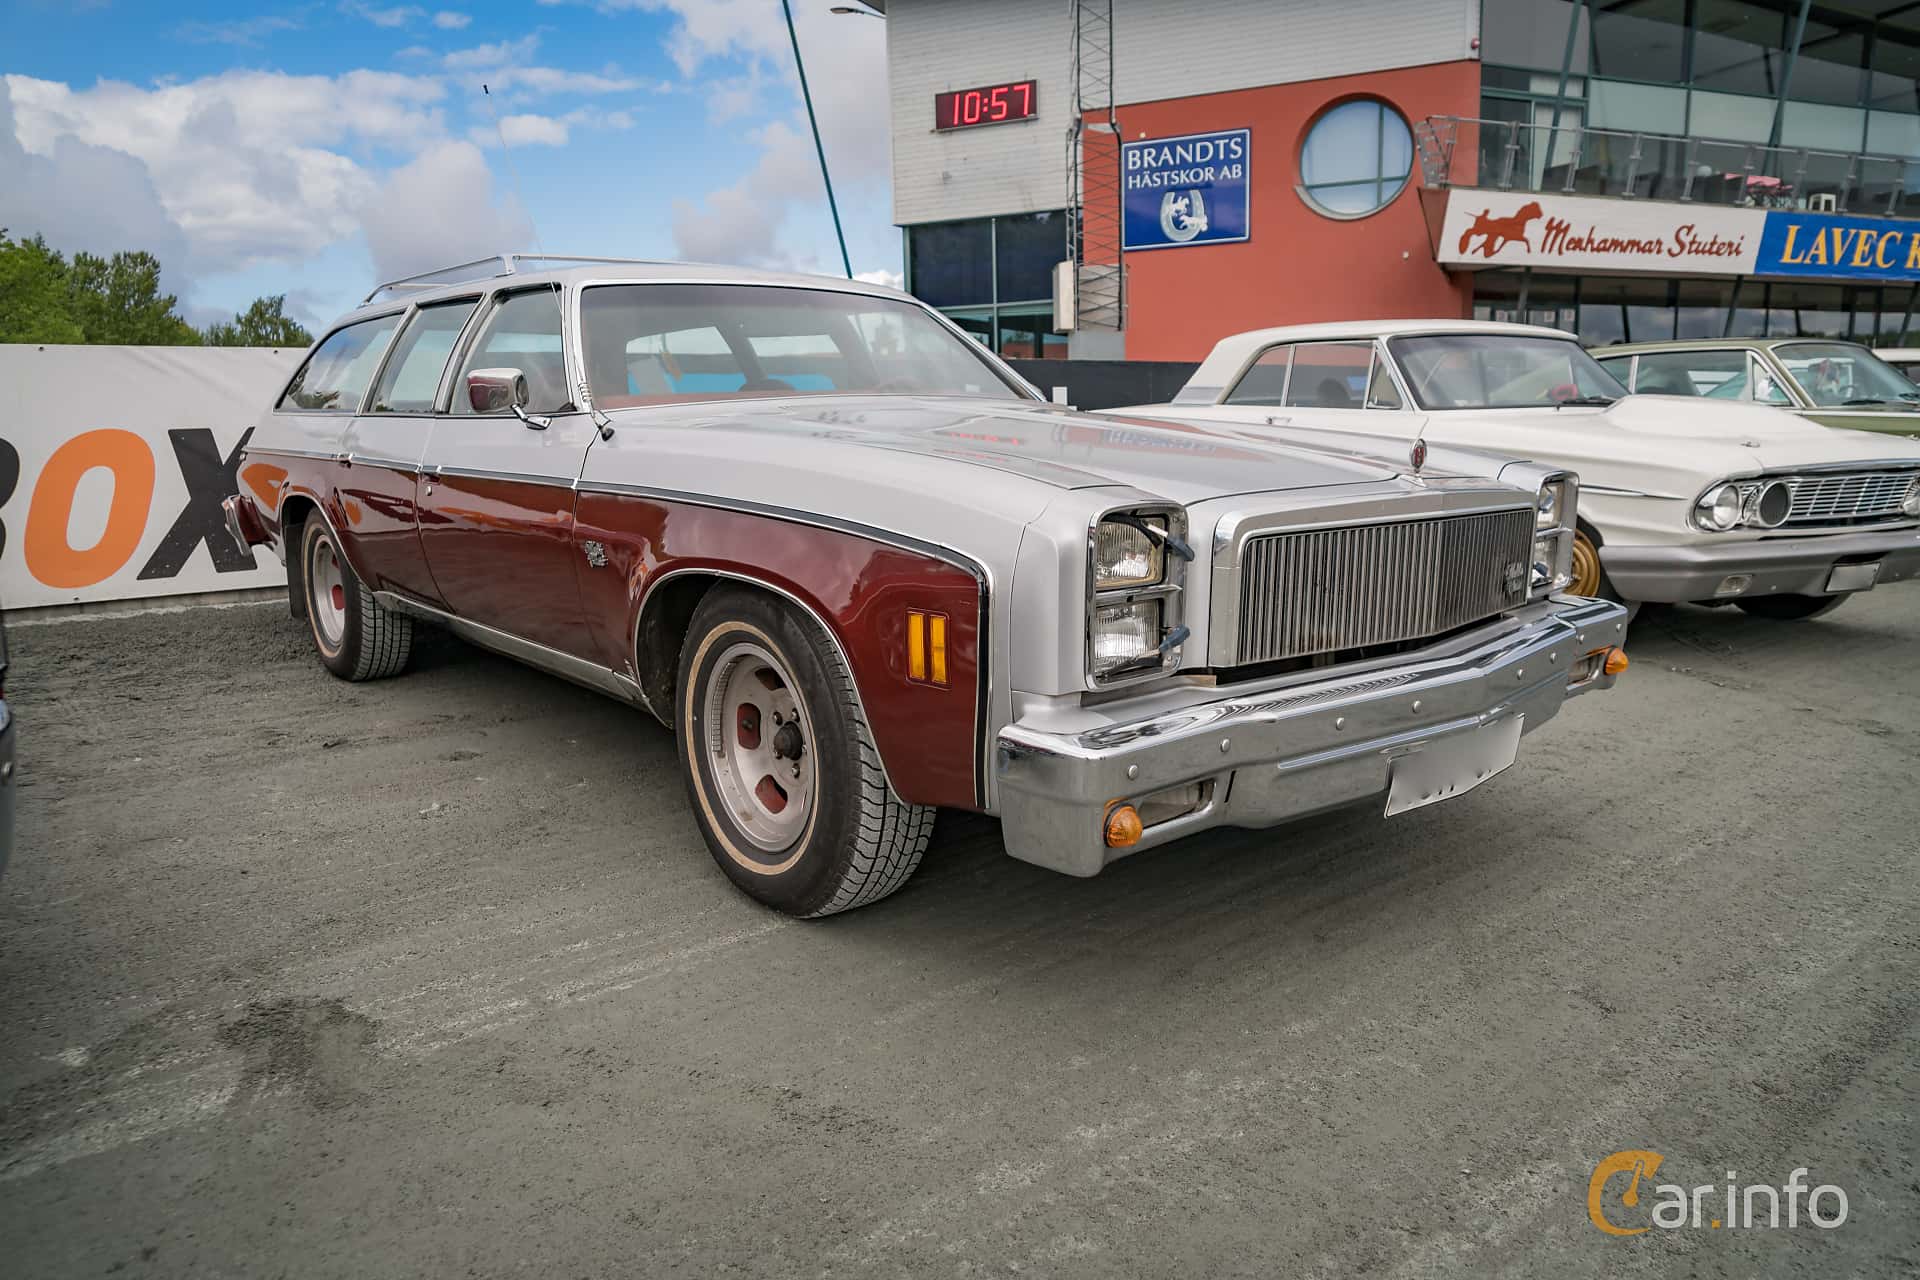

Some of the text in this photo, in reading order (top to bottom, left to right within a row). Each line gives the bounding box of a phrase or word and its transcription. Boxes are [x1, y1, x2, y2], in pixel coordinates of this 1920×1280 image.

[952, 82, 1031, 126] 10:57
[1127, 137, 1243, 171] BRANDTS
[1127, 163, 1242, 190] HÄSTSKOR AB
[1540, 216, 1745, 258] Menhammar Stuteri
[1779, 224, 1904, 269] LAVEC
[0, 426, 257, 589] OX
